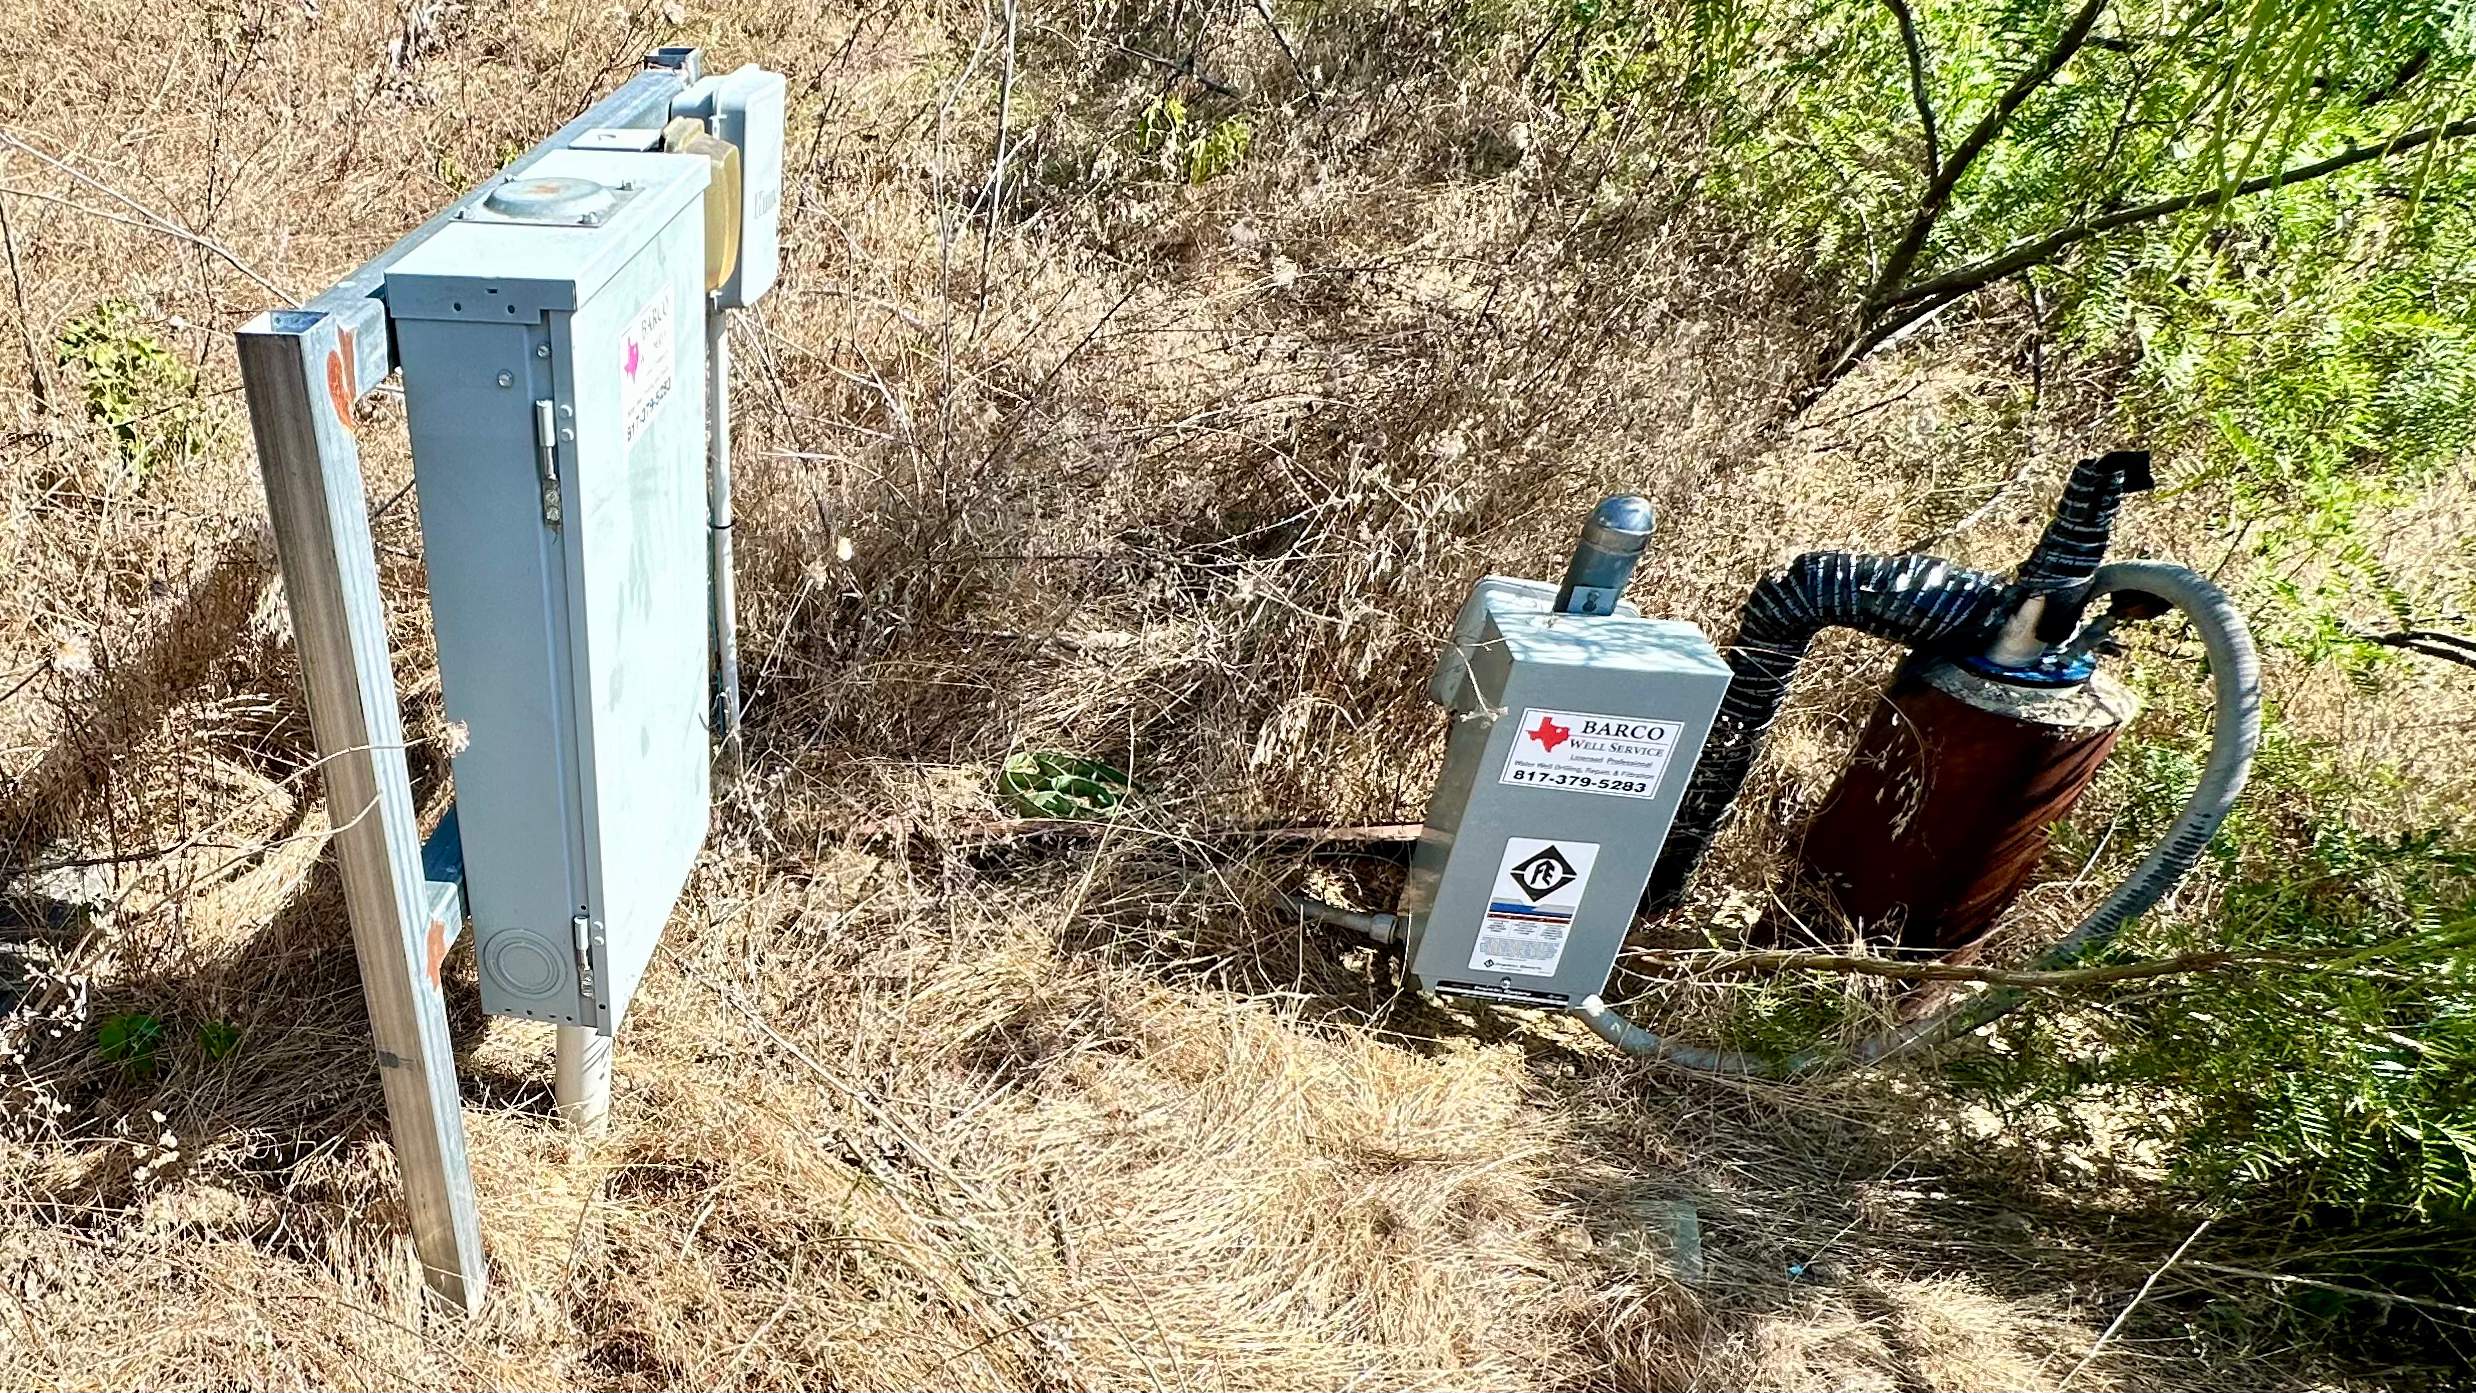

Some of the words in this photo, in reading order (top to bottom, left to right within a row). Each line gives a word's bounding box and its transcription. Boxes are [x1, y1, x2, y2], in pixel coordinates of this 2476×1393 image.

[1582, 720, 1665, 741] BARCO
[1608, 743, 1665, 757] SERVICE
[1513, 769, 1647, 793] 817-379-5283
